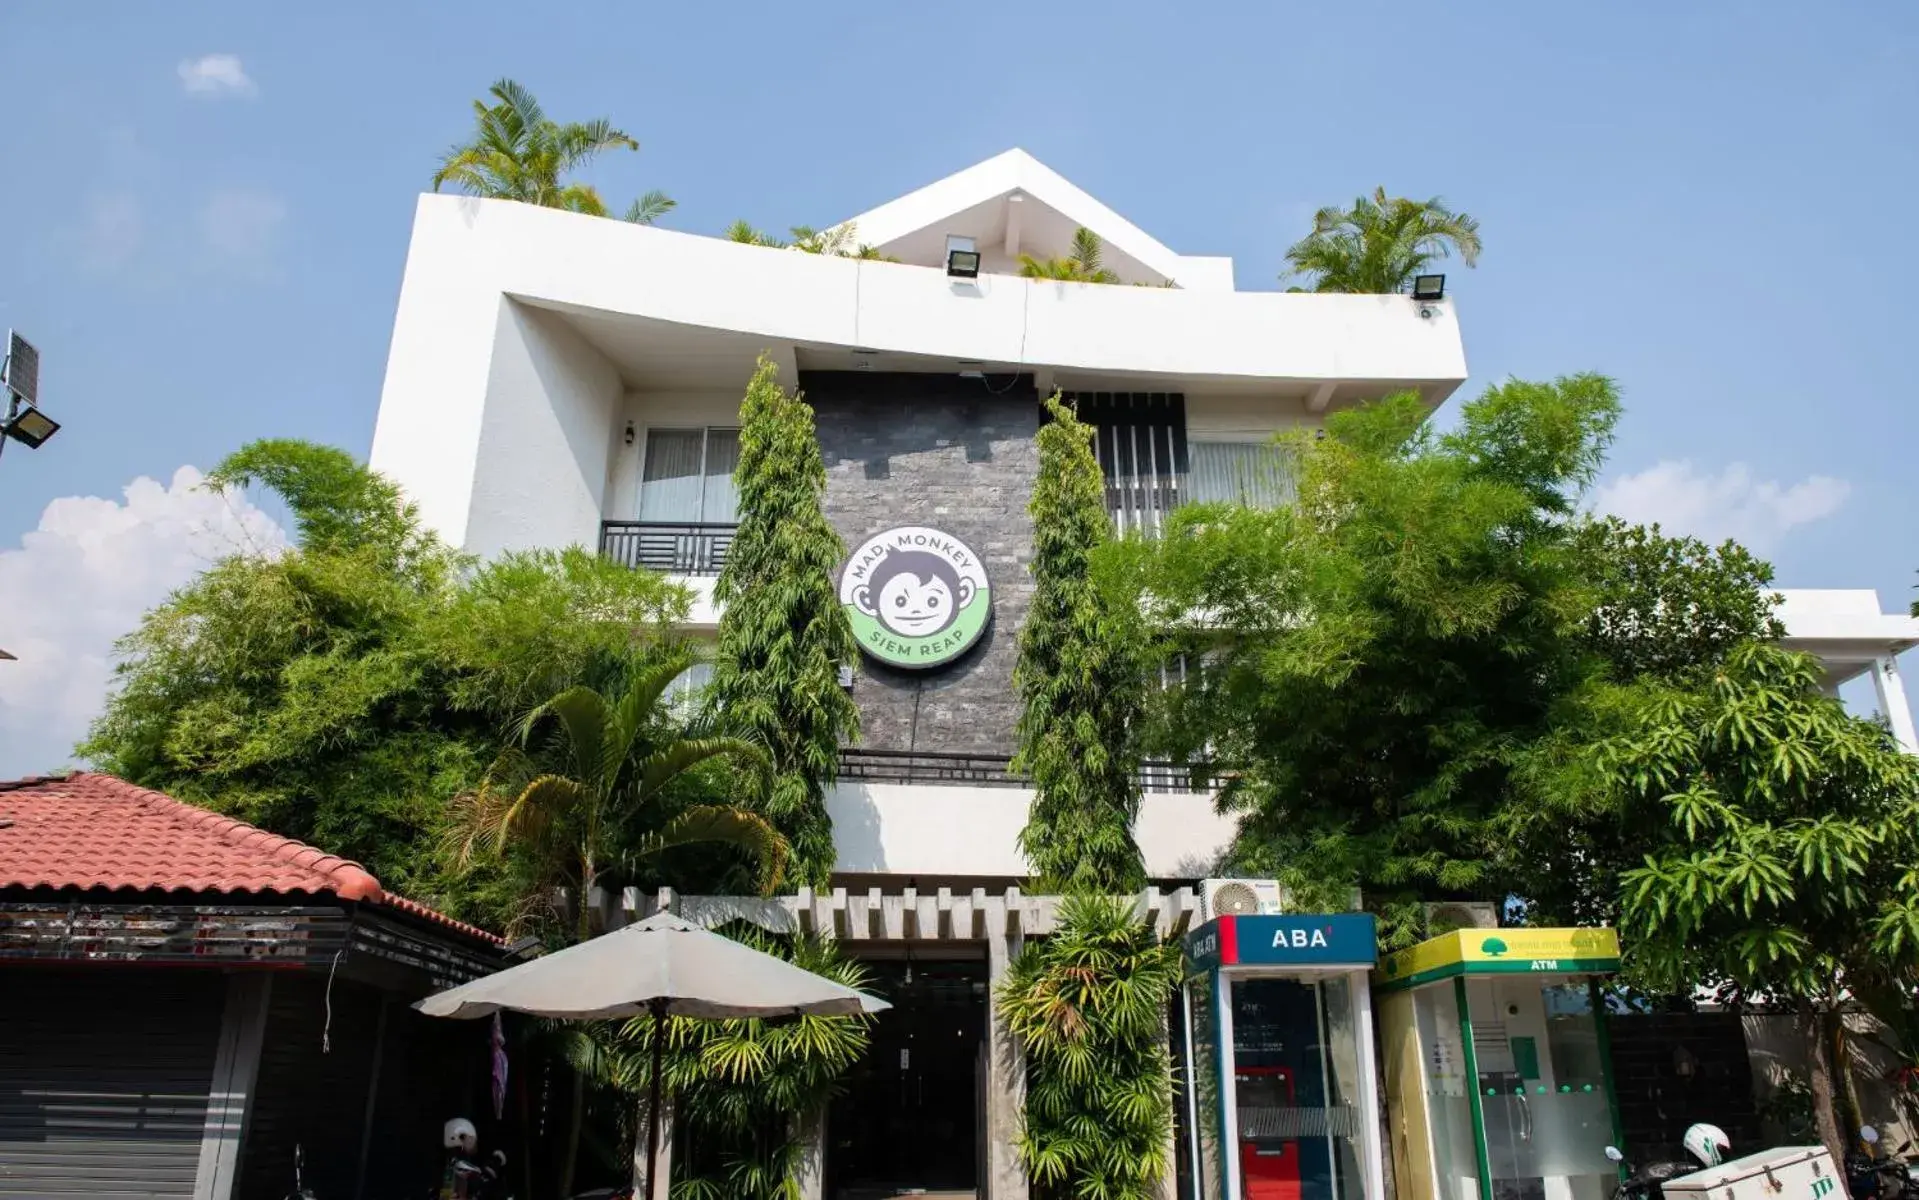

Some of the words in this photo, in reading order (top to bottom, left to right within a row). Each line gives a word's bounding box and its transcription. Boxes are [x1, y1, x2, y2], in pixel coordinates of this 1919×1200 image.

[852, 545, 884, 579] MAD
[898, 535, 973, 570] MONKEY
[870, 631, 911, 656] SIEM
[920, 630, 963, 656] REAP
[1272, 929, 1328, 948] ABA
[1531, 960, 1557, 970] ATM
